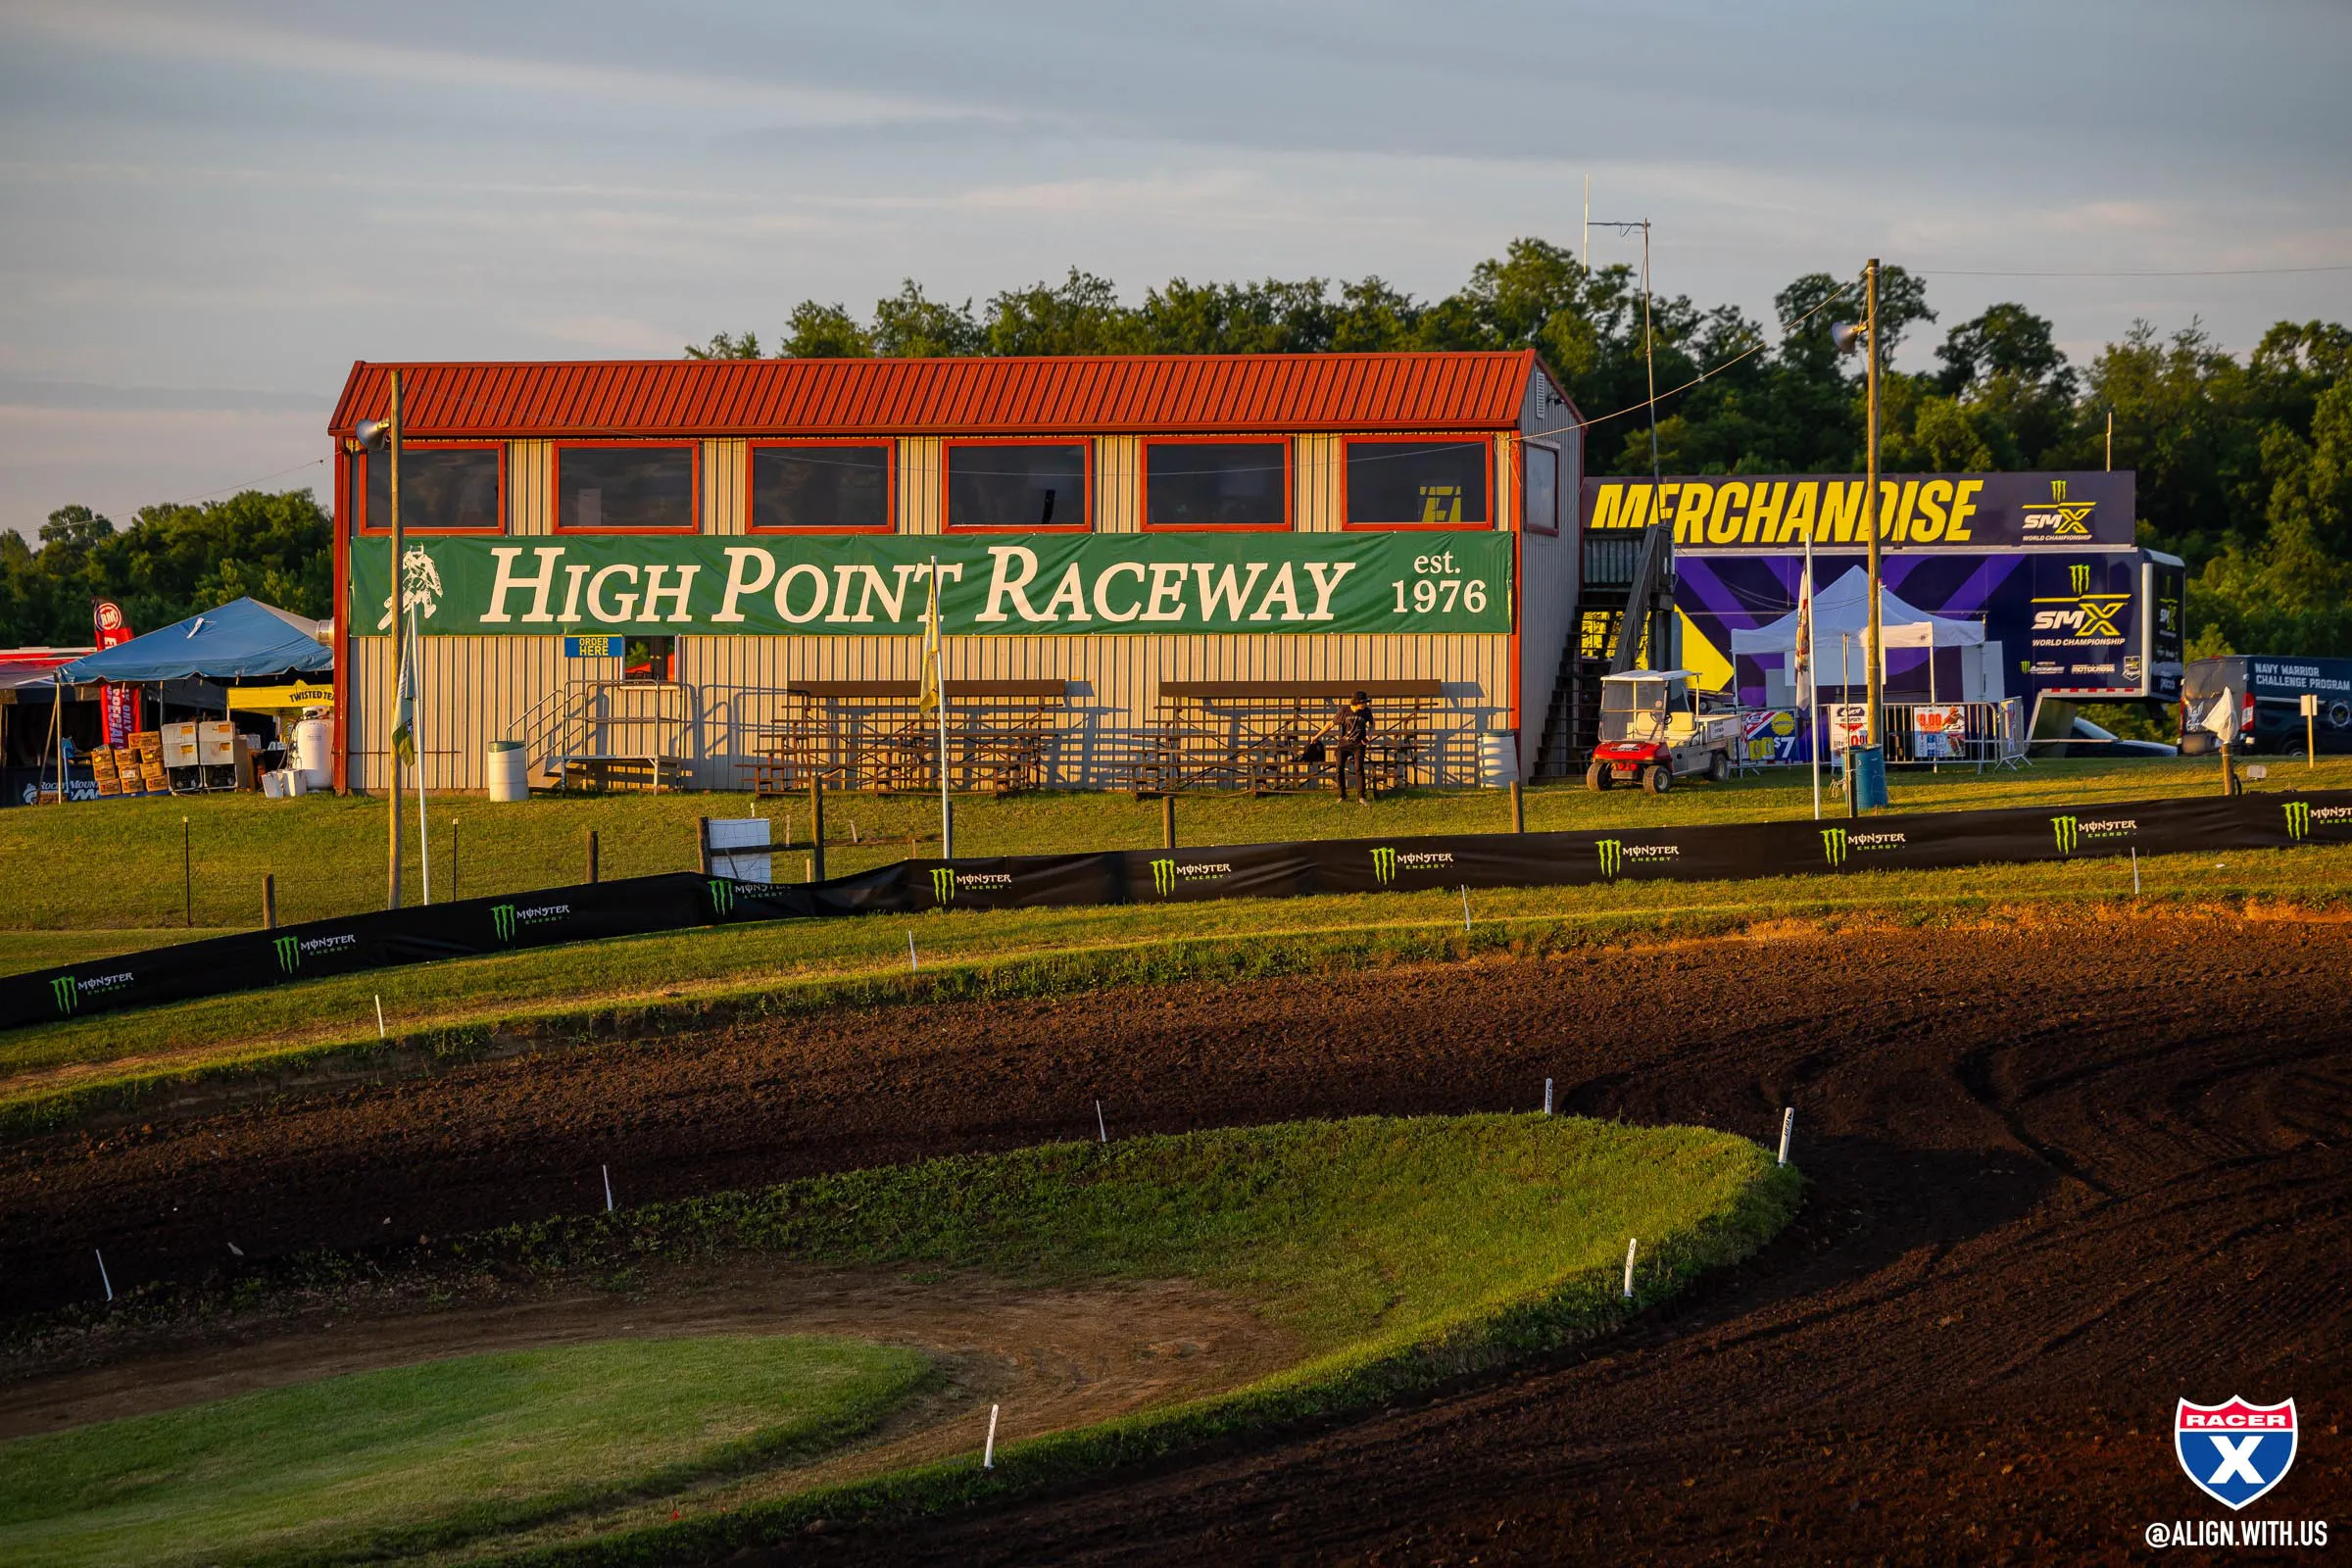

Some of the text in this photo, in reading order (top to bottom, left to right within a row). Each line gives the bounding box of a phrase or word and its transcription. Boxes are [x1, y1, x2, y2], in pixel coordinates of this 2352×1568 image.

[1591, 479, 1984, 544] MERCHANDISE
[2022, 508, 2092, 534] SMX
[1413, 551, 1461, 574] est.
[479, 545, 1357, 623] HIGH POINT RACEWAY
[1392, 579, 1487, 613] 1976
[2031, 602, 2127, 637] SMX
[2062, 638, 2126, 647] CHAMPIONSHIP
[579, 646, 609, 656] HERE
[2255, 663, 2320, 677] NAVY WARRIOR
[2256, 674, 2351, 691] CHALLENGE PROGRAM
[289, 690, 322, 703] TWISTED
[1774, 736, 1795, 759] $7
[2310, 807, 2352, 818] MONST
[2078, 819, 2137, 833] MONSTER
[1847, 832, 1906, 846] MONSTER
[1396, 852, 1453, 864] MONSTER
[1622, 845, 1680, 858] MONSTER
[1176, 863, 1232, 875] MONSTER
[956, 873, 1012, 885] MONSTER
[516, 904, 570, 919] MONSTER
[300, 934, 357, 951] MONSTER
[77, 971, 134, 990] MONSTER
